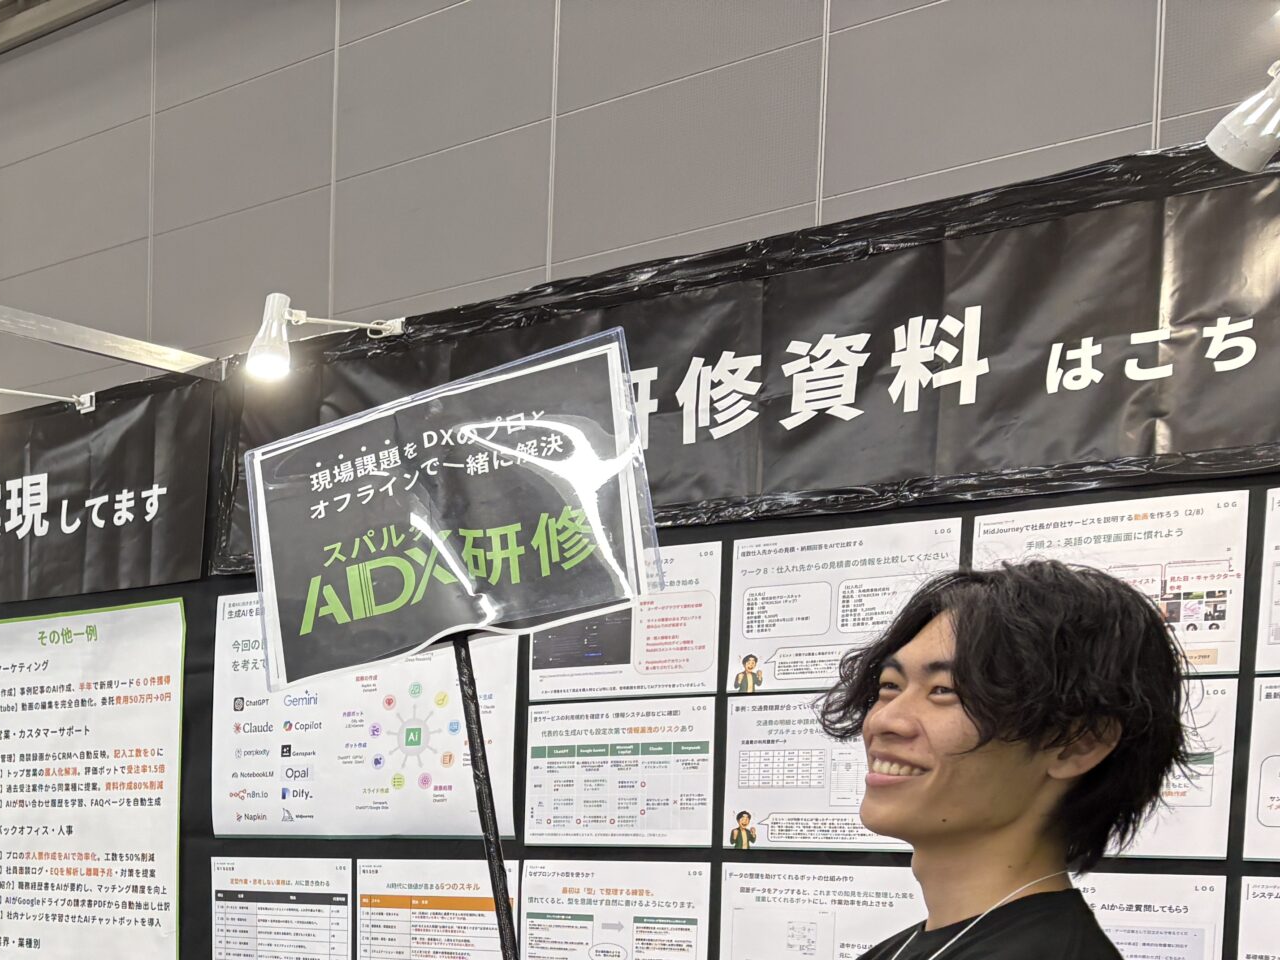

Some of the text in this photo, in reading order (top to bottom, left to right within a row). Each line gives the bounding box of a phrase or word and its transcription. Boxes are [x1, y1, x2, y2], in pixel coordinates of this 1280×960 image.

[1217, 501, 1238, 509] LOG
[37, 624, 98, 646] その他一例
[246, 699, 269, 707] ChatGPT
[283, 693, 318, 707] Gemini
[242, 722, 274, 734] Claude
[294, 721, 322, 732] Copilot
[768, 728, 822, 736] ダブルチェックをAI
[292, 750, 316, 758] Genspark
[240, 771, 274, 779] NotebookLM
[285, 768, 309, 781] Opal
[246, 790, 269, 799] n8n.io
[244, 813, 267, 823] Napkin
[728, 872, 855, 883] データの整理を助けてくれるボットの仕組み作り
